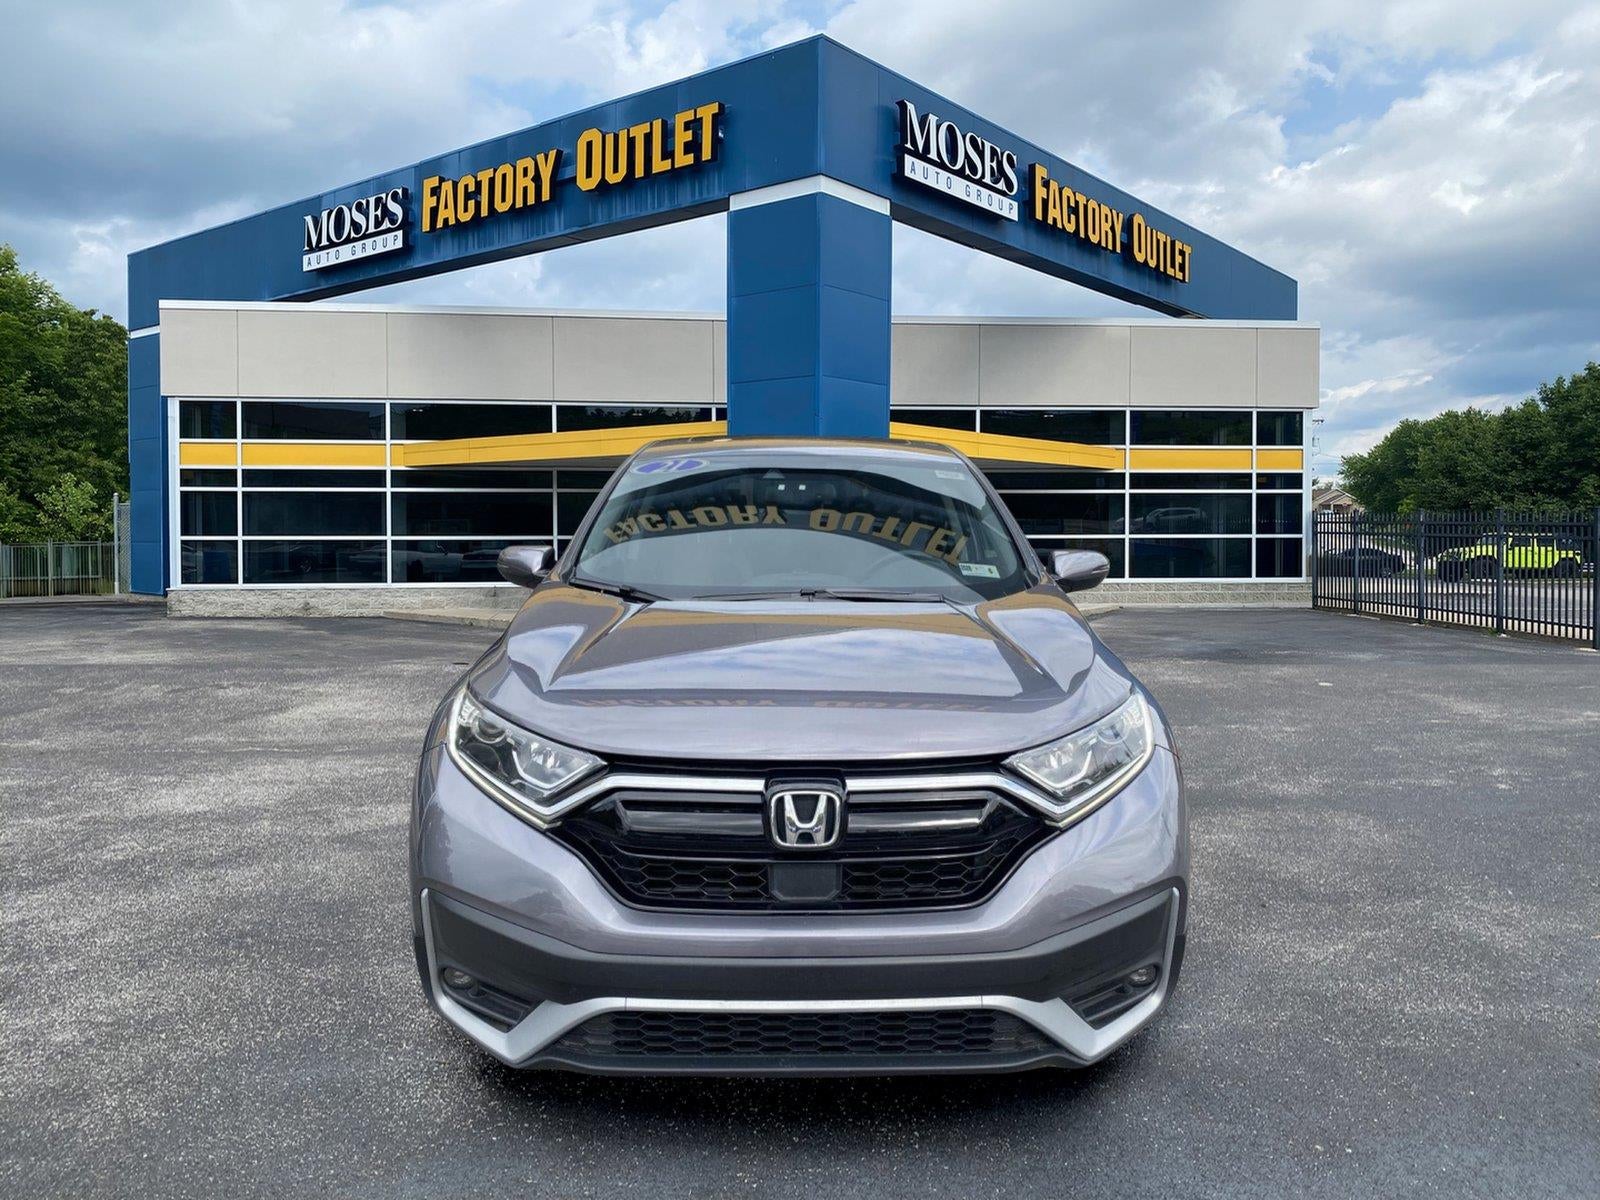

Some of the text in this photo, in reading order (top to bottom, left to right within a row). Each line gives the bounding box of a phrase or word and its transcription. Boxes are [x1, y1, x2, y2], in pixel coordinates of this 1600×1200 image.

[422, 101, 720, 233] FACTORY OUTLET
[904, 99, 1019, 196] MOSES
[909, 160, 1014, 214] AUTO GROUP
[303, 187, 403, 251] MOSES
[306, 234, 399, 267] AUTO GROUP
[1034, 162, 1192, 283] FACTORY OUTLET
